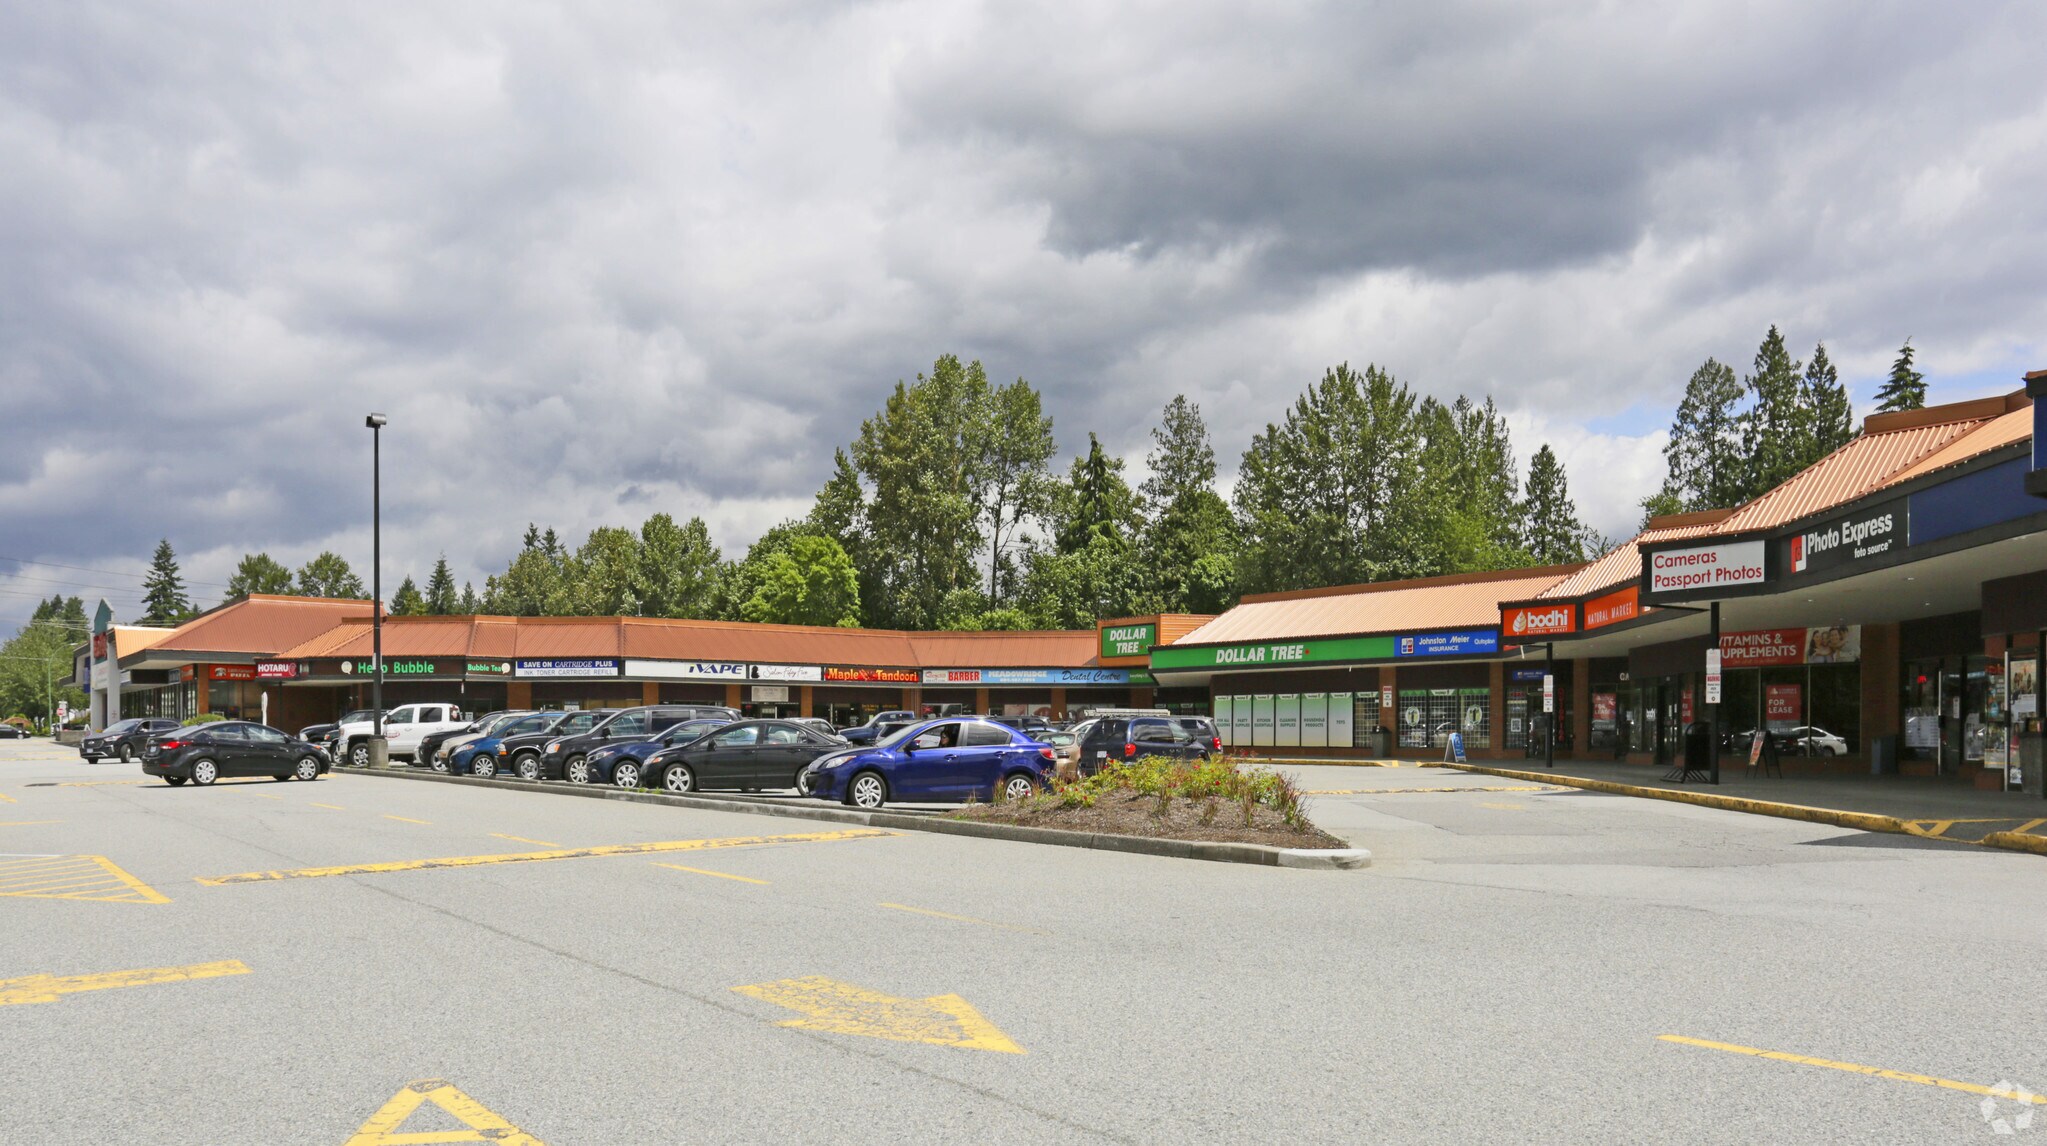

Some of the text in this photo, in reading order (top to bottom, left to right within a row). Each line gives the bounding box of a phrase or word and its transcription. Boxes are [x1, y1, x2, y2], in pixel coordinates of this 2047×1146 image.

[1808, 514, 1892, 555] Photo Express
[1854, 547, 1867, 558] foto
[1654, 551, 1717, 569] Cameras
[1654, 565, 1762, 589] Passport Photos
[1527, 609, 1568, 628] bodhi
[1587, 602, 1632, 626] NATURAL MARKET
[1109, 628, 1147, 642] DOLLAR
[1418, 637, 1446, 646] Johnston
[1773, 633, 1783, 644] &
[1116, 641, 1139, 654] TREE
[1720, 645, 1797, 660] UPPLEMENTS
[1216, 645, 1304, 664] DOLLAR TREE
[258, 664, 289, 673] HOTARU
[357, 661, 434, 674] Heo Bubble
[467, 663, 502, 672] Bubble Tea
[827, 668, 859, 682] Maple
[875, 669, 917, 682] Tandoori
[948, 671, 980, 682] BARBER
[1062, 670, 1092, 682] Dental
[1093, 670, 1121, 682] Centre
[1768, 706, 1793, 714] LEASE
